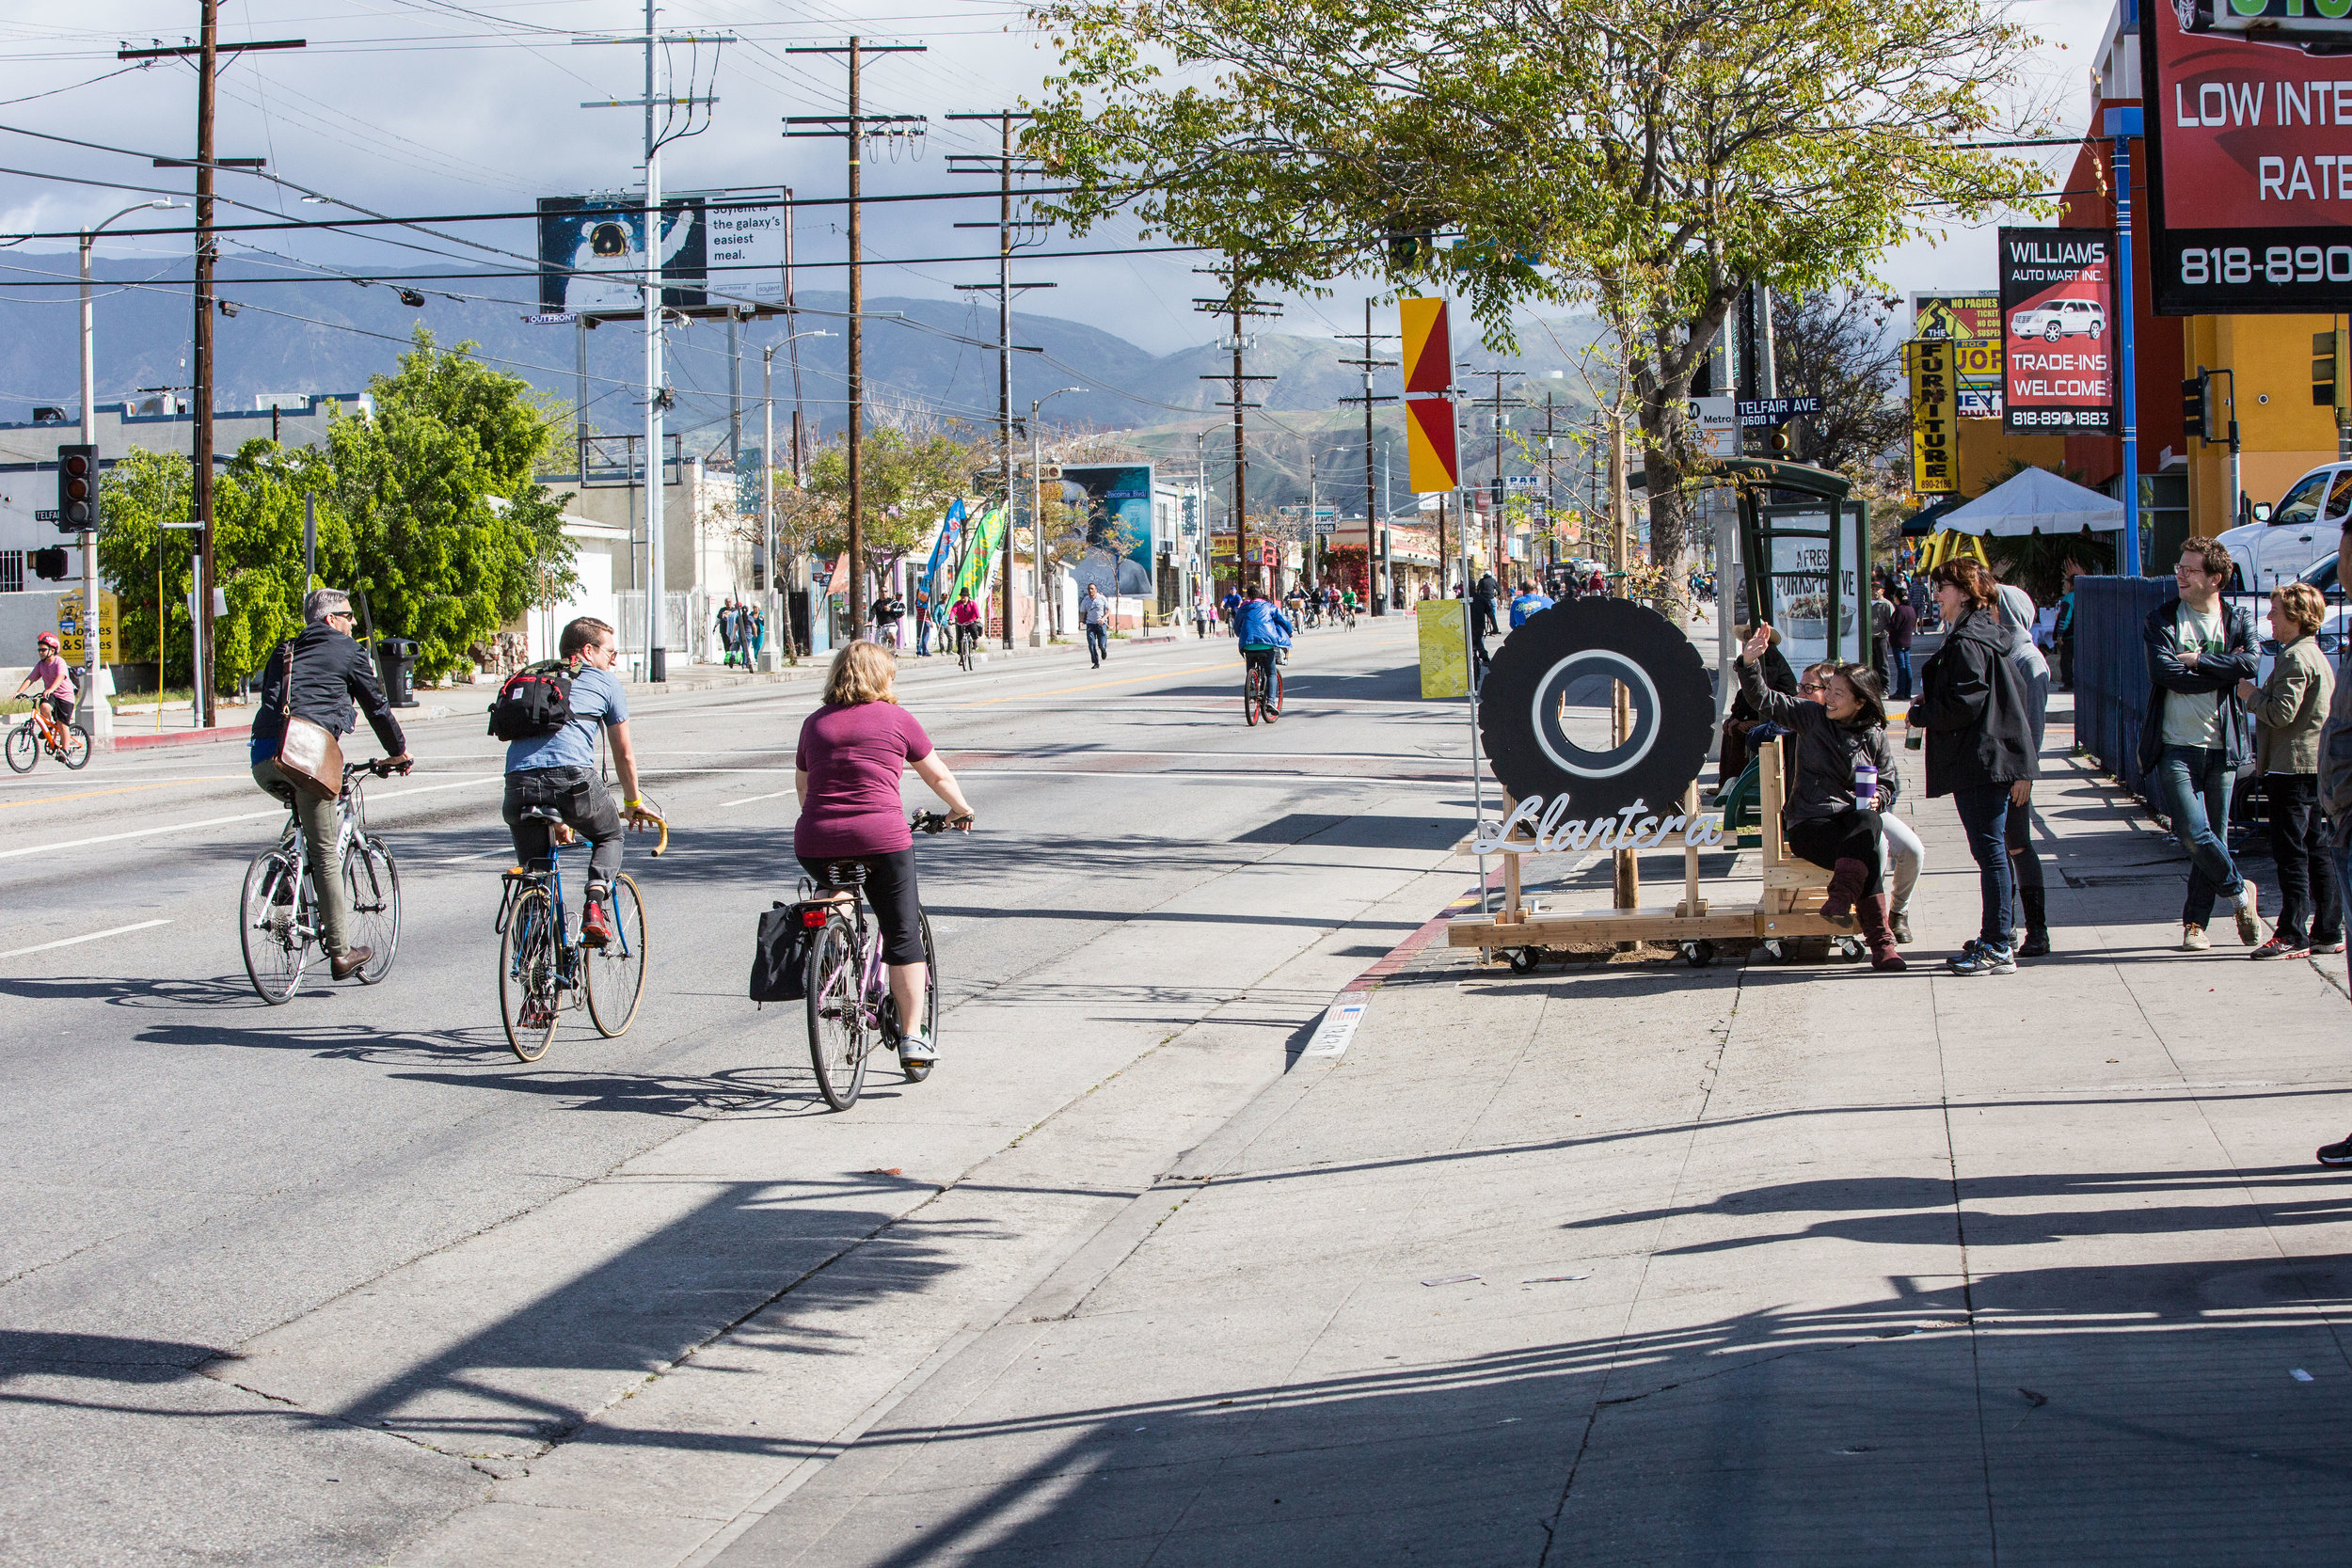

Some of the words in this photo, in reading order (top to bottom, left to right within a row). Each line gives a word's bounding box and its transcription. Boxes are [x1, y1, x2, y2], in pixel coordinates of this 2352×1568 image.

[2175, 82, 2265, 128] LOW
[713, 219, 734, 230] the
[736, 216, 781, 231] galaxy's
[714, 234, 754, 245] easiest
[714, 249, 746, 261] meal.
[2010, 242, 2106, 264] WILLIAMS
[2180, 245, 2352, 285] 818-890
[2011, 269, 2044, 281] AUTO
[2046, 269, 2080, 281] MART
[2081, 269, 2104, 281] INC.
[1950, 298, 1963, 309] NO
[1964, 298, 1998, 309] PAGUES
[531, 313, 577, 323] OUTFRONT
[1977, 309, 1999, 318] TICKET
[1977, 320, 1986, 328] NO
[2011, 354, 2107, 371] TRADE-INS
[2013, 379, 2106, 396] WELCOME
[1739, 399, 1788, 416] TELFAIR
[1793, 398, 1821, 412] AVE.
[1921, 343, 1947, 478] FURNITURE
[1704, 415, 1732, 424] Metro
[2012, 411, 2109, 426] 818-890-1883
[1215, 538, 1260, 549] FIETA
[1797, 550, 1804, 569] A
[1804, 548, 1830, 568] FRES
[1771, 568, 1855, 599] PORKSPEVE
[62, 624, 111, 637] Cloes
[73, 639, 111, 651] Ses
[1471, 793, 1723, 855] Llantera
